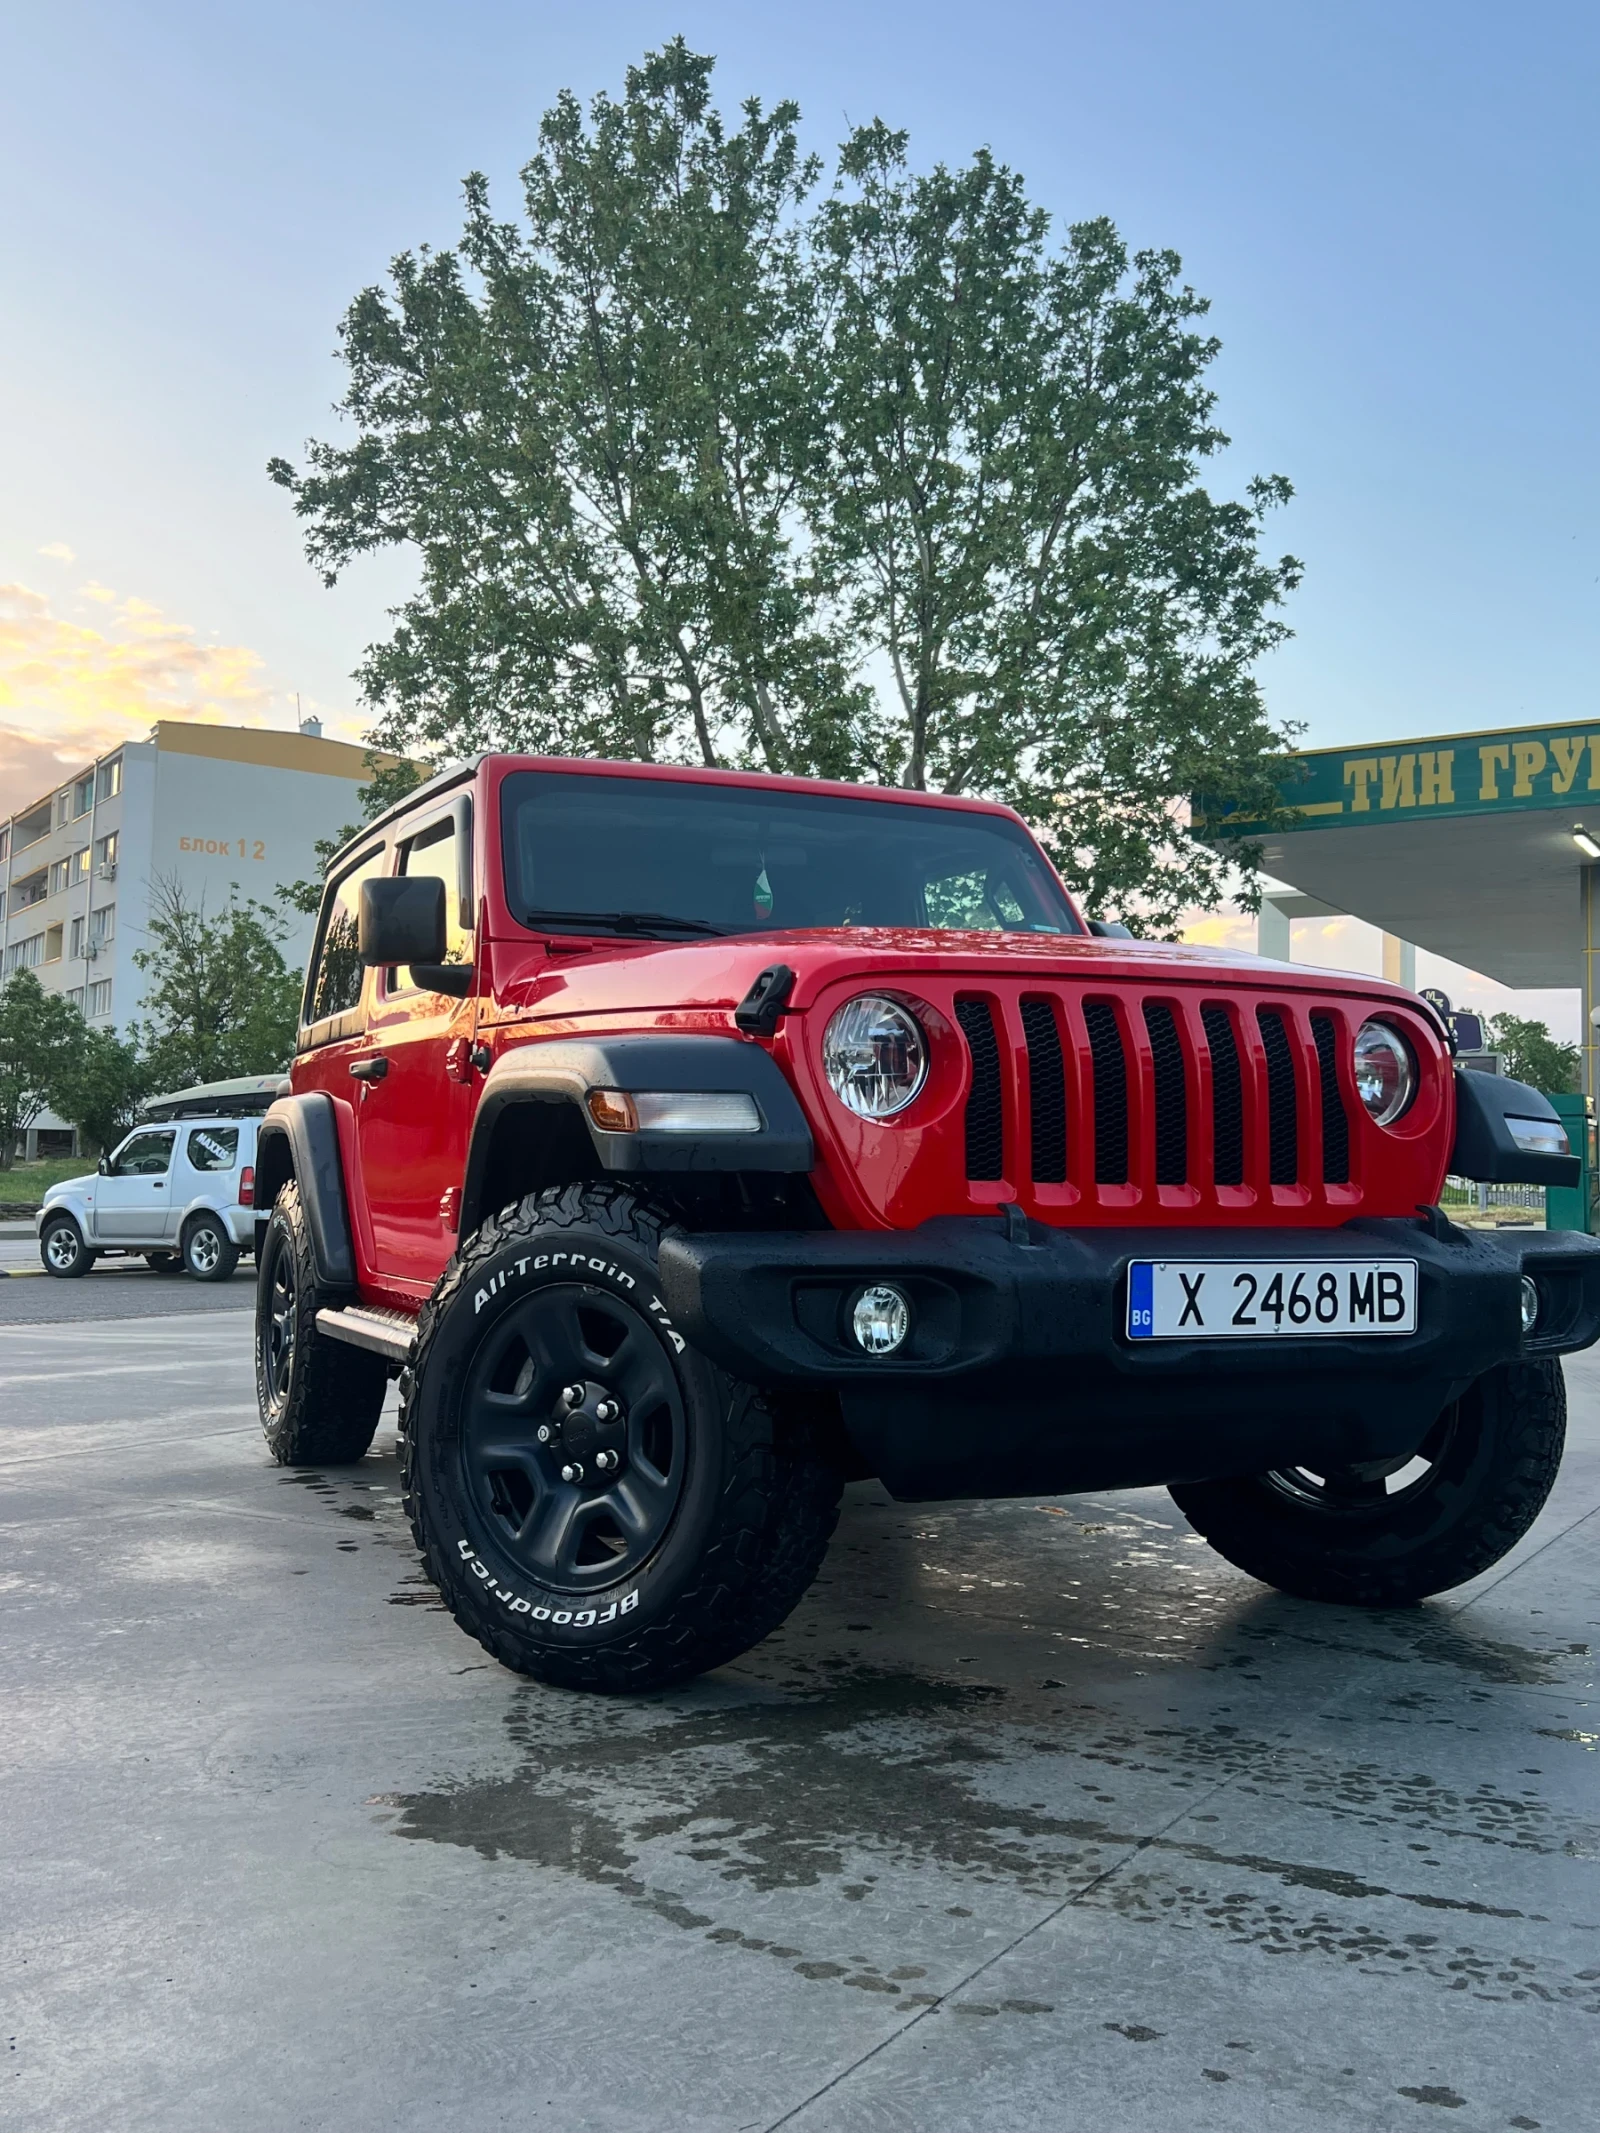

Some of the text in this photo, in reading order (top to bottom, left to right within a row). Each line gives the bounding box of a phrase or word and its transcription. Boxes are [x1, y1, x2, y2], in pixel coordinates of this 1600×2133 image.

[1343, 749, 1455, 812] ТИН
[179, 836, 230, 857] БЛОК
[195, 1132, 229, 1161] MAXXIS
[474, 1252, 637, 1315] All-Terrain
[1177, 1271, 1406, 1327] X 2468 MB
[1131, 1309, 1151, 1326] BG
[457, 1539, 640, 1628] BFGoodrich
